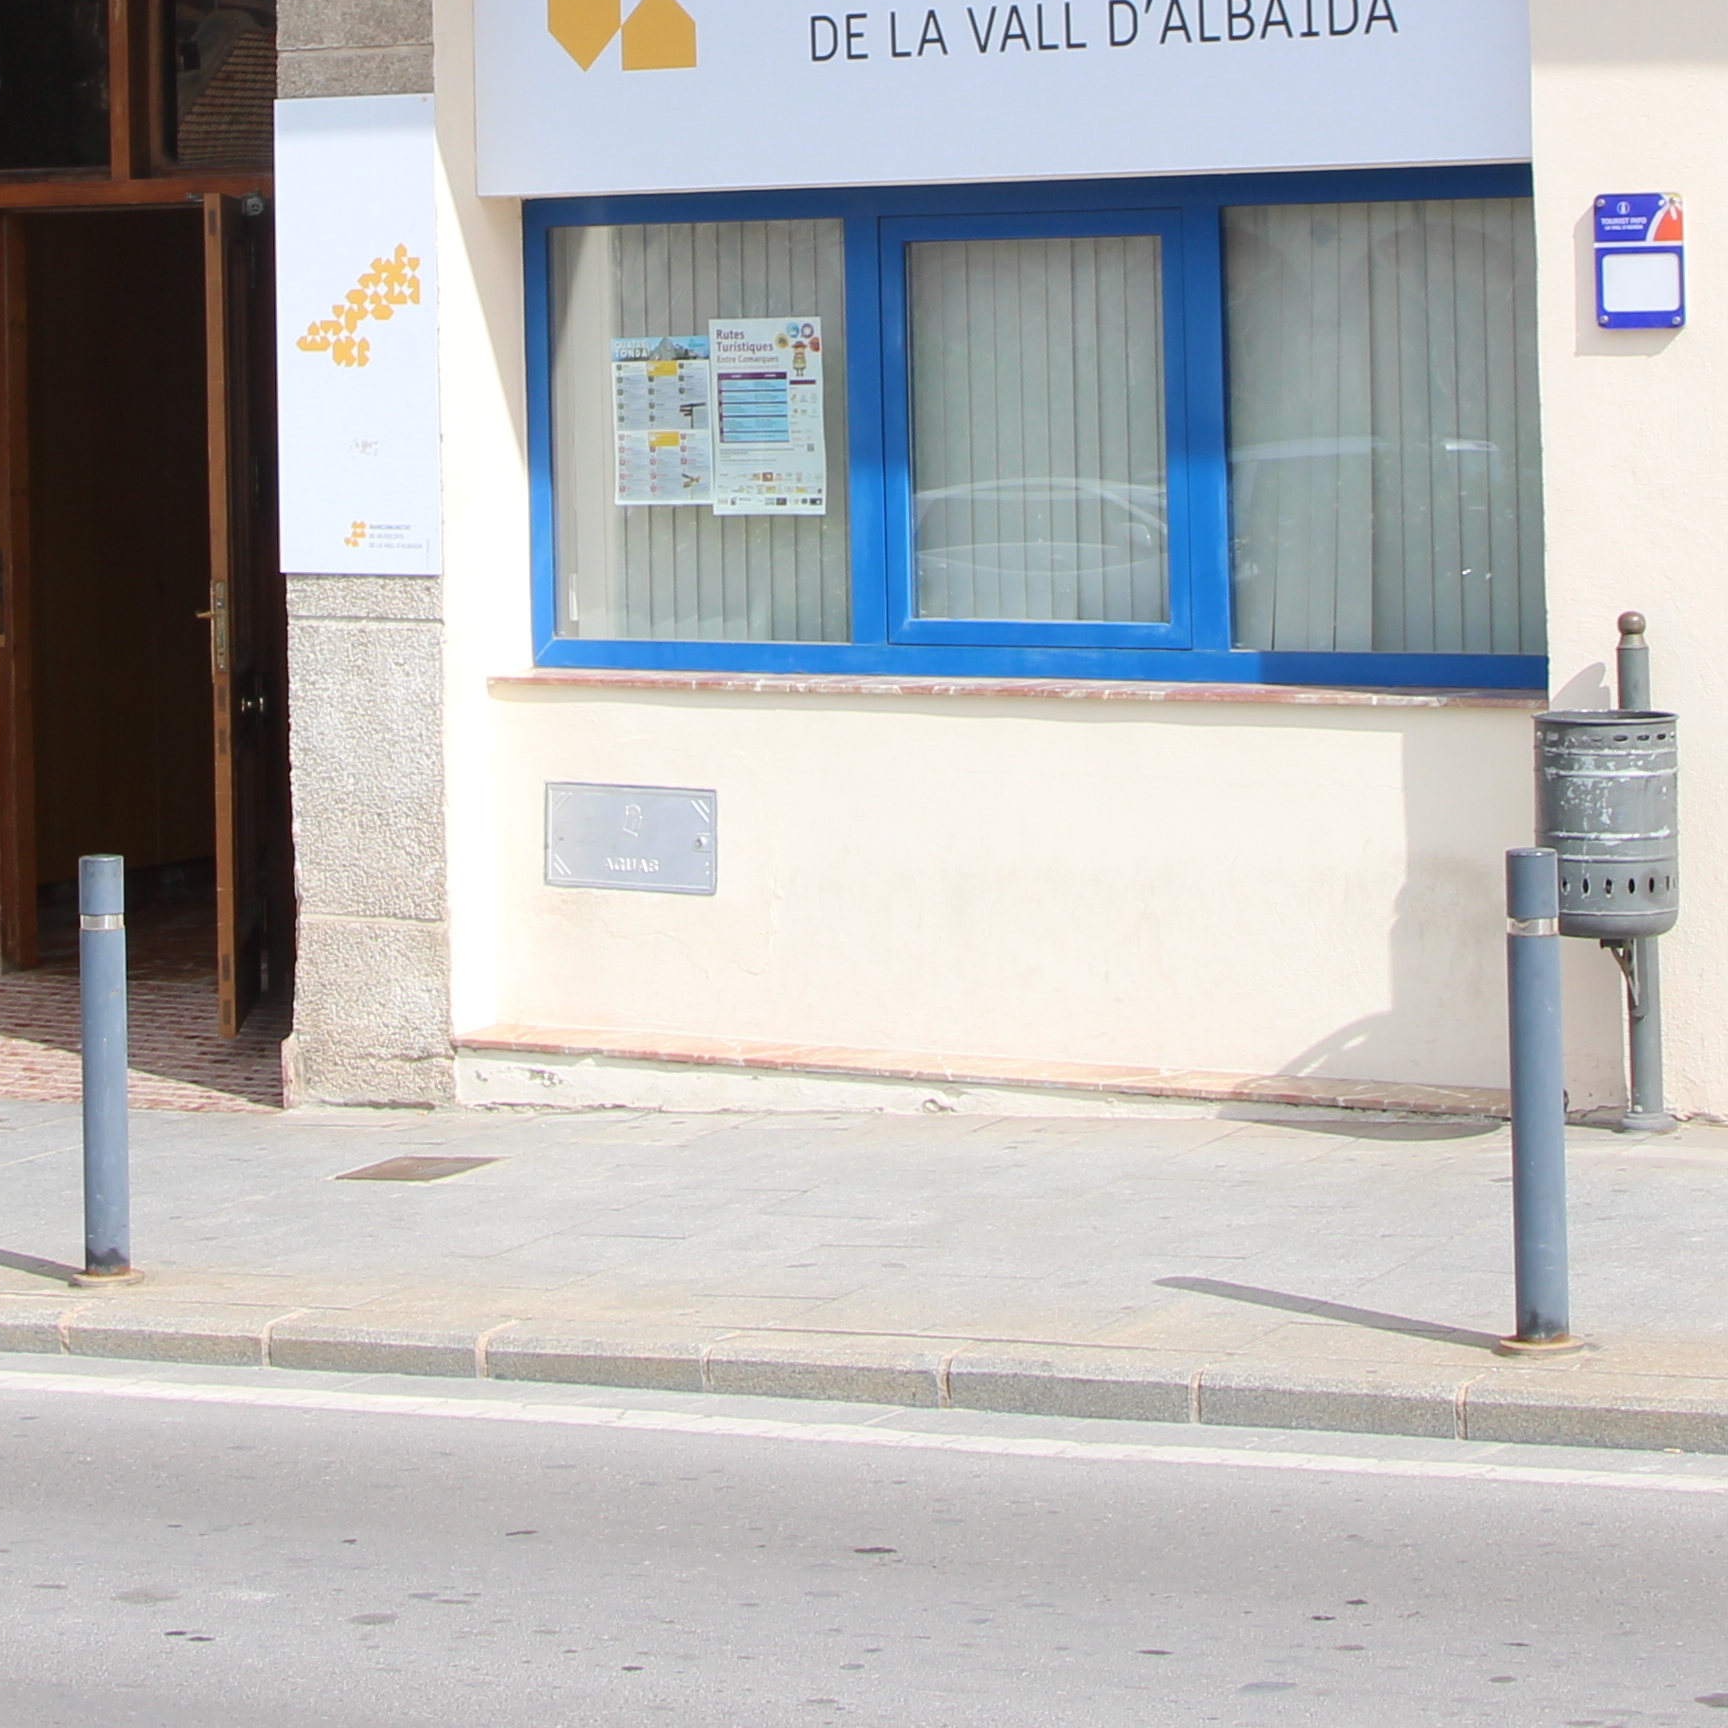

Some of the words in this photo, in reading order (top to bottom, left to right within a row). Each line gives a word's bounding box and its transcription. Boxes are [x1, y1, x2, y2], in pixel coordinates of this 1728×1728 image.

[809, 13, 869, 63] DE
[888, 9, 948, 59] LA
[966, 0, 1088, 56] VALL
[716, 329, 745, 340] Rutes
[716, 340, 774, 355] Turístiques
[615, 350, 648, 358] TONDA
[717, 355, 736, 363] Entre
[737, 354, 779, 364] Comarques
